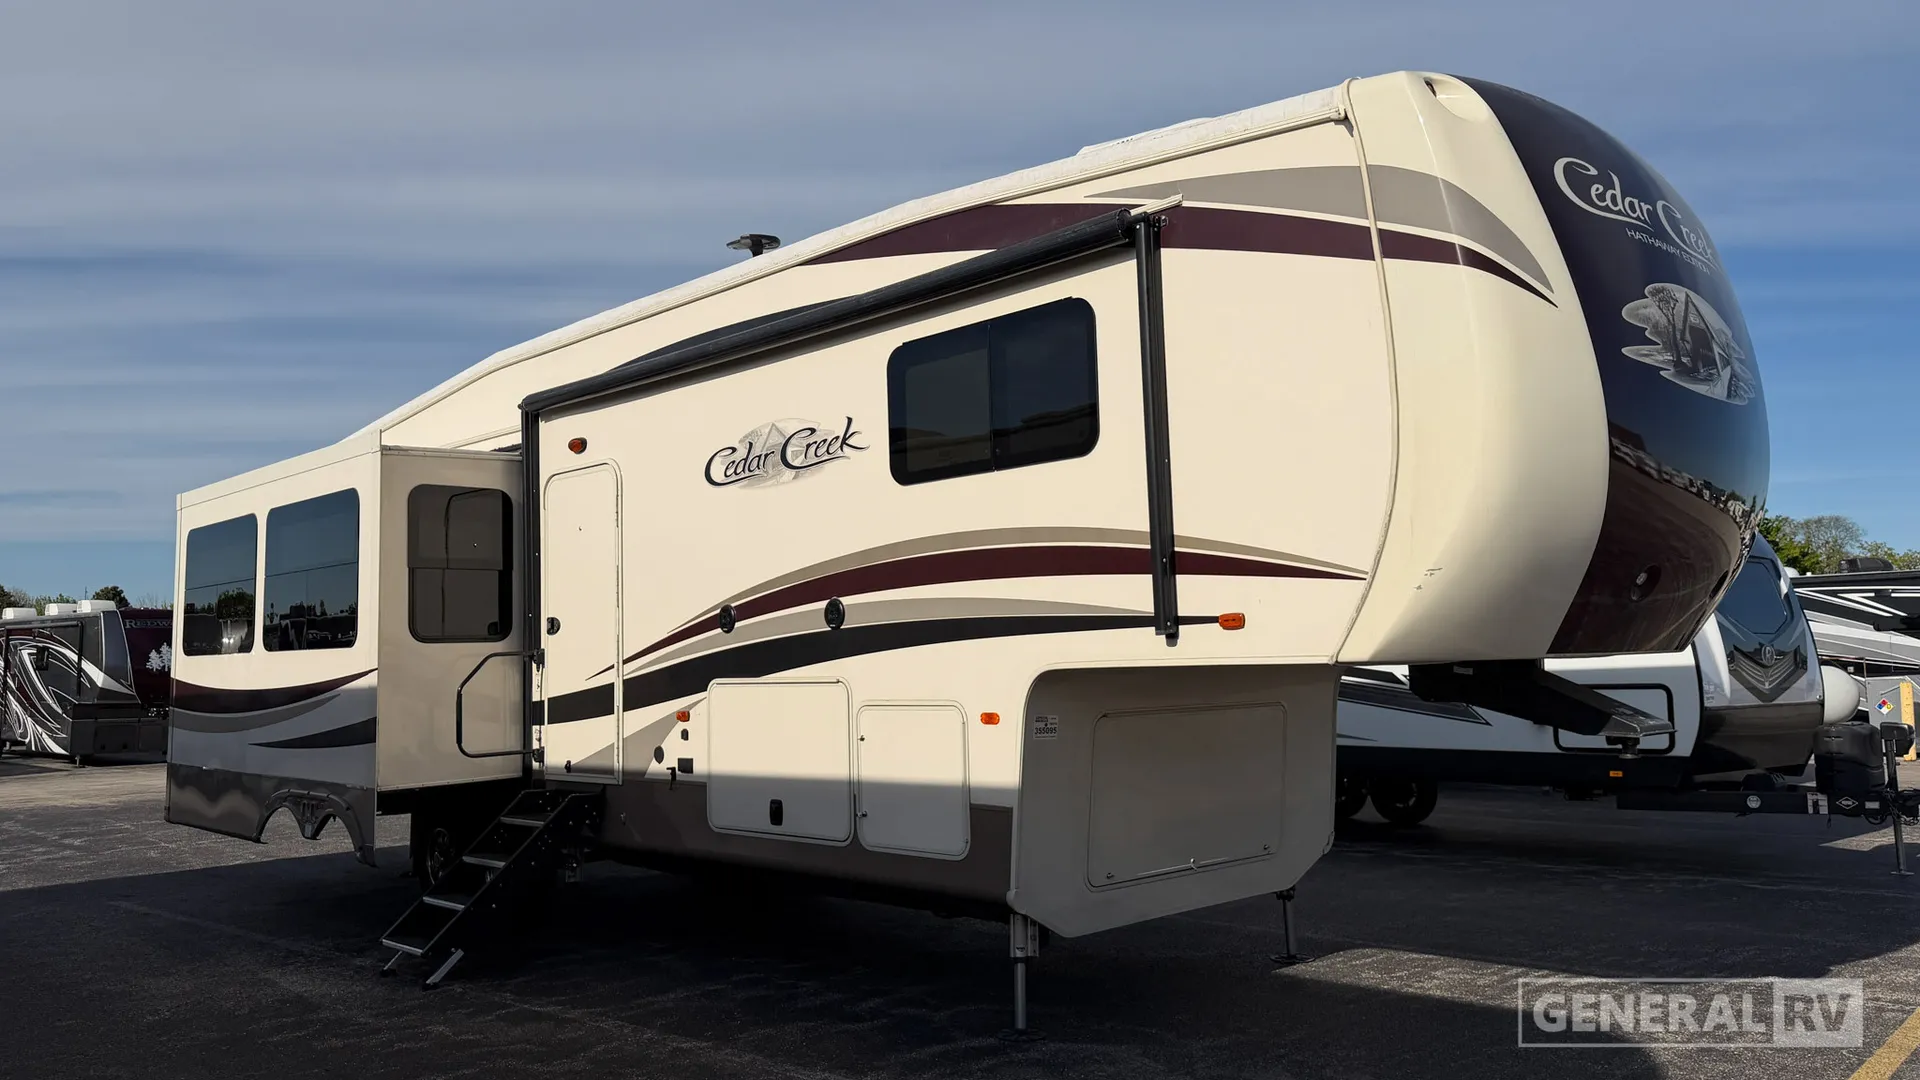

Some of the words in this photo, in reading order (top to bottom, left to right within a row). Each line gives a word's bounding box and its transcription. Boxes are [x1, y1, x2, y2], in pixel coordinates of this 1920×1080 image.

[1554, 157, 1654, 231] Cedar
[1656, 200, 1720, 271] Creek
[1625, 227, 1681, 257] HATHAWAY
[704, 441, 775, 486] Cedar
[780, 416, 870, 470] Creek
[125, 619, 173, 628] REDW
[1034, 727, 1058, 735] 355095
